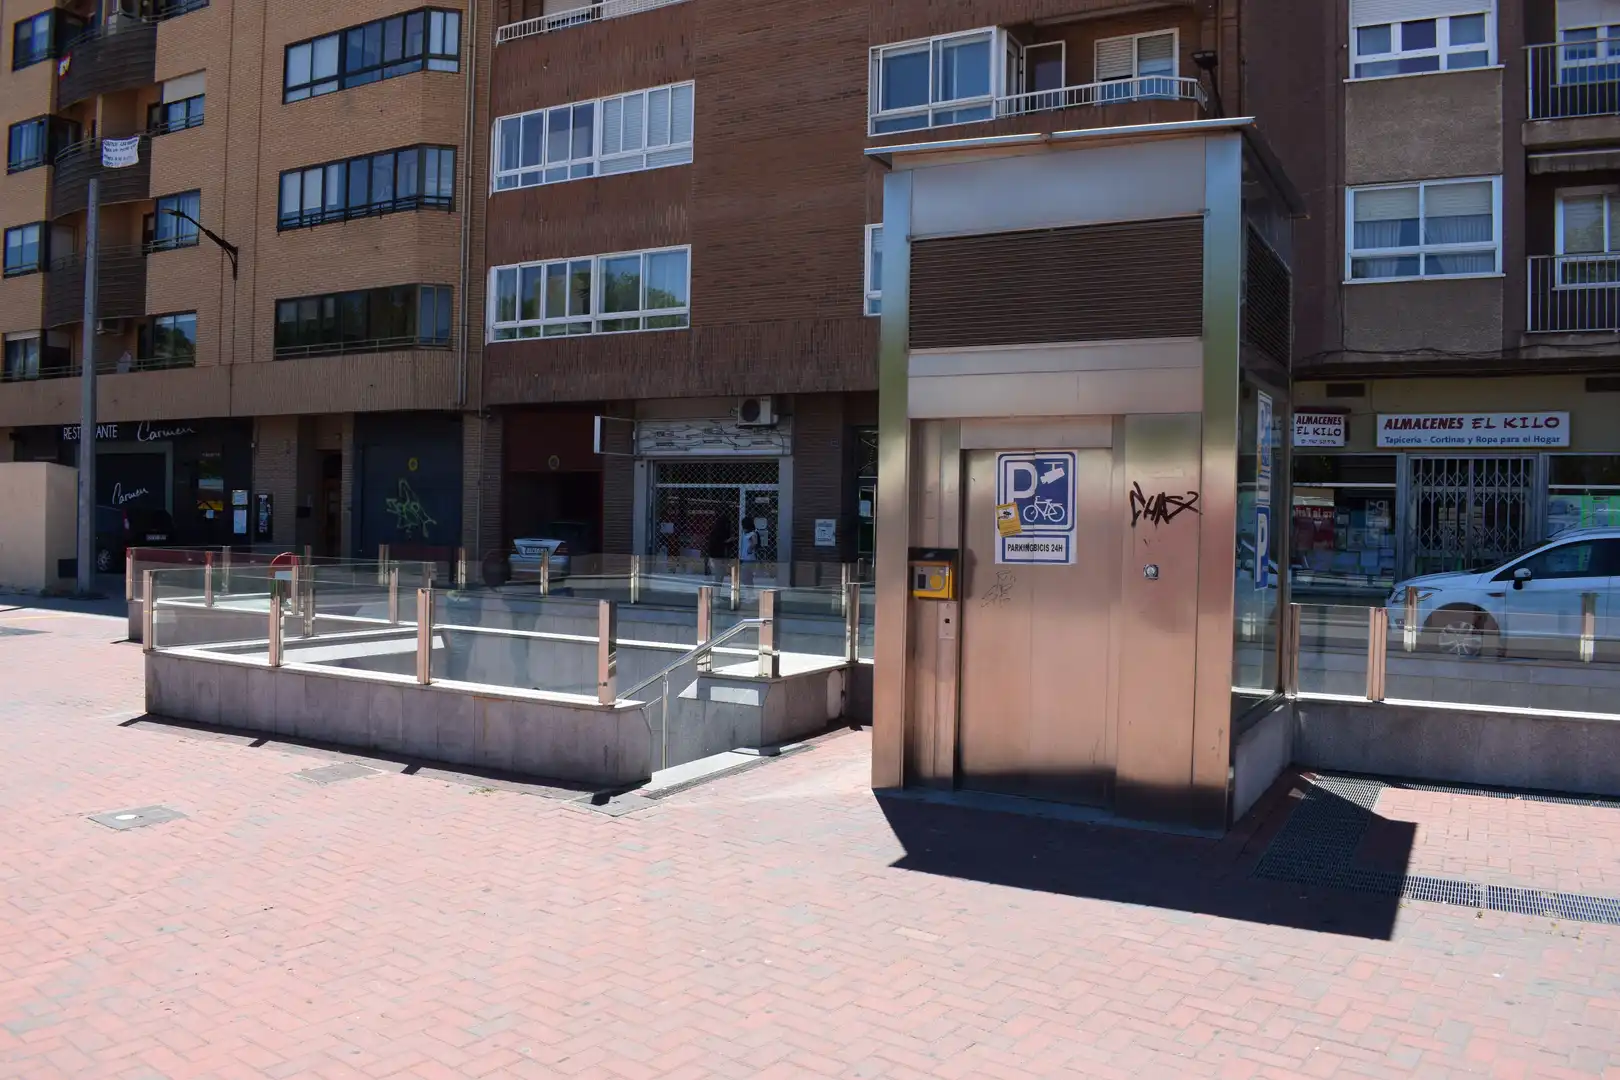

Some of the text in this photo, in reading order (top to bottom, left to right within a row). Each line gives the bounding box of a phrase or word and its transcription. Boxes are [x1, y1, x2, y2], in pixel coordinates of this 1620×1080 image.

[1296, 415, 1342, 425] ALMACENES
[1384, 416, 1560, 430] ALMACENES EL KILO
[63, 420, 196, 441] RESTANTE Carmen
[1296, 426, 1342, 436] EL KILO
[1430, 435, 1465, 444] Cortinas
[1467, 437, 1474, 445] y
[1476, 435, 1498, 444] Ropa
[1500, 437, 1520, 445] para
[1522, 435, 1531, 443] el
[1533, 435, 1561, 445] Hogar
[1006, 462, 1038, 504] P
[112, 482, 150, 504] Carmen
[1051, 544, 1063, 553] 24H
